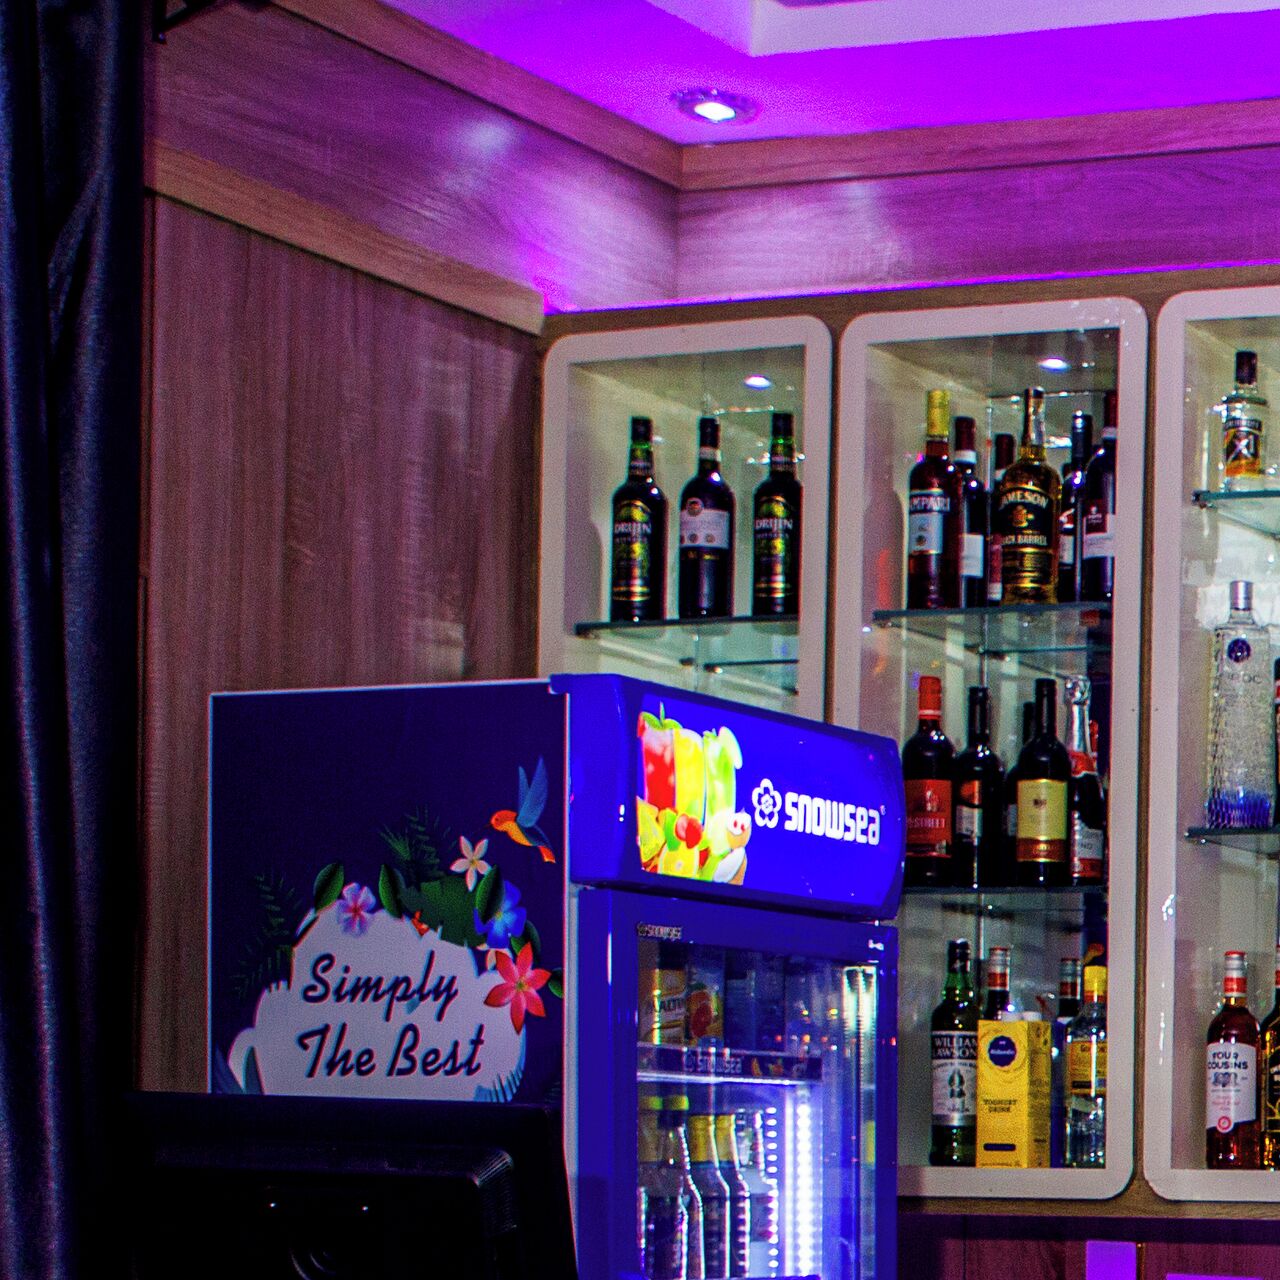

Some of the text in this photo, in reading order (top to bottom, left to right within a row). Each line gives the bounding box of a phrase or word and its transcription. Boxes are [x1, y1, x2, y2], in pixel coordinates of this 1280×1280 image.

[301, 950, 459, 1023] Simply
[297, 1022, 486, 1079] The Best
